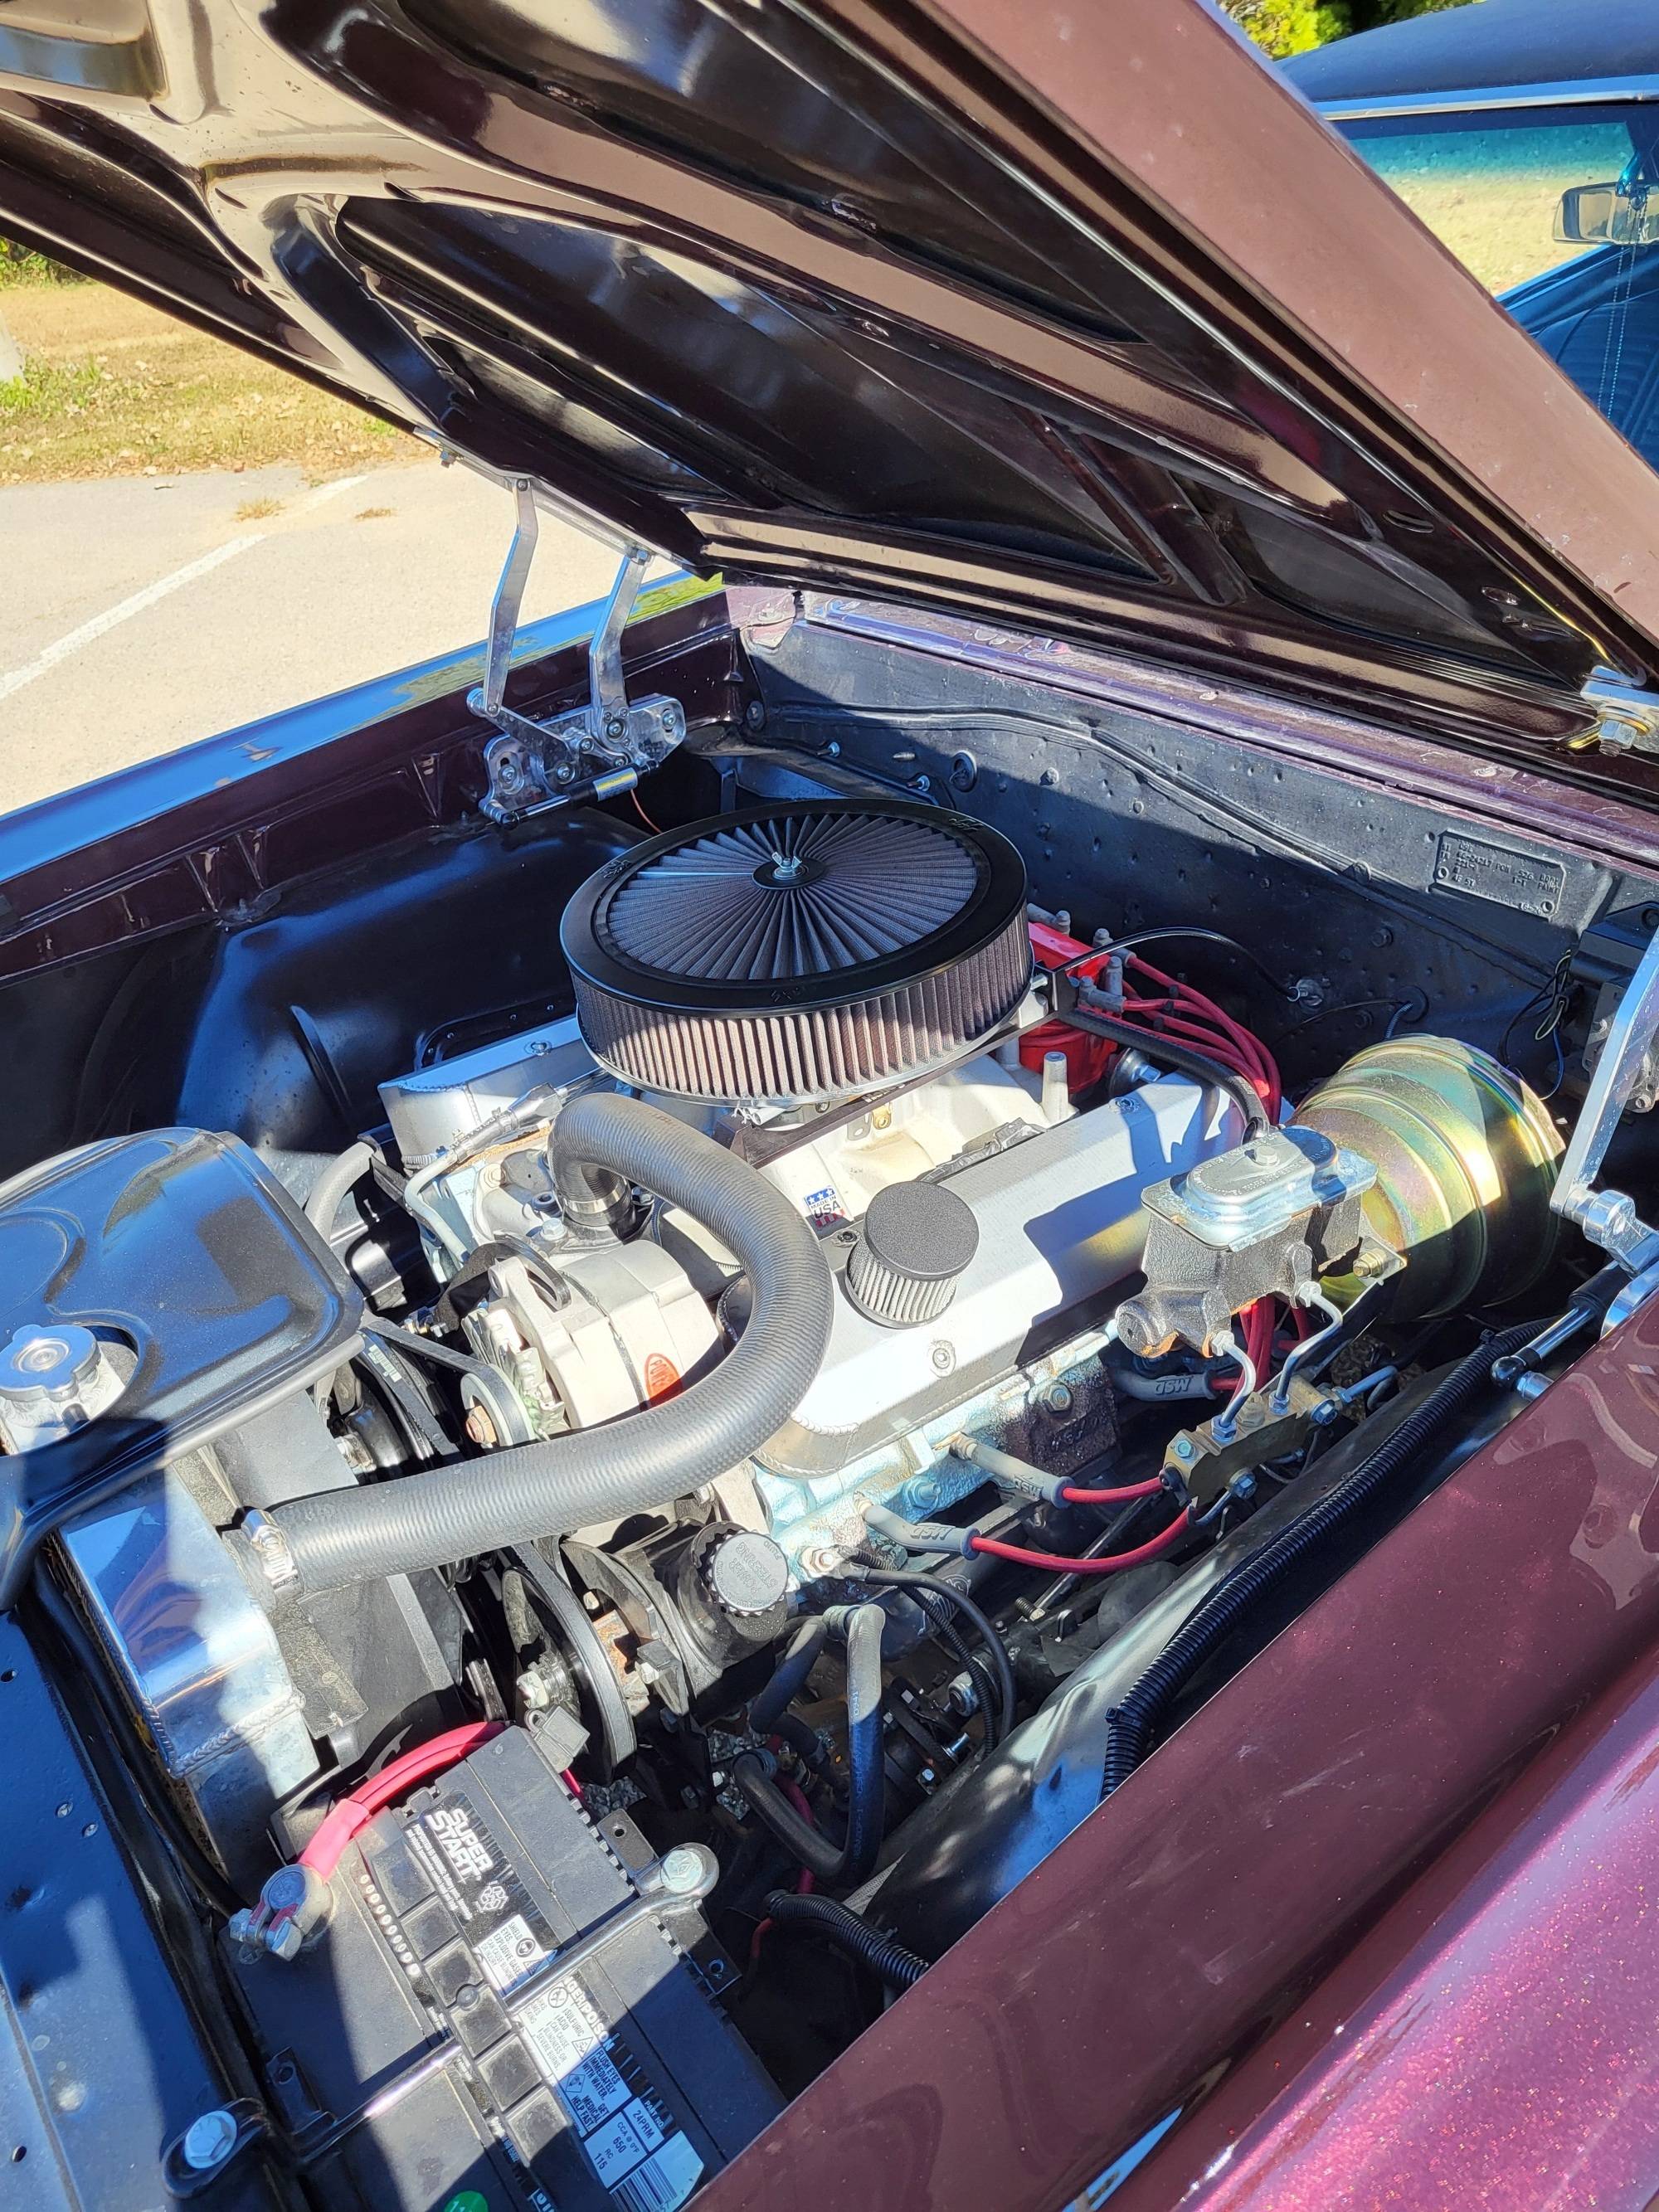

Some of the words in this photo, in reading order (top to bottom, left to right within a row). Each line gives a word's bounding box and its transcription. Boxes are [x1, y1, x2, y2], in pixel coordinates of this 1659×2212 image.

[810, 1198, 828, 1209] MADE
[814, 1200, 841, 1218] USA
[1154, 1377, 1192, 1396] MSD
[1014, 1474, 1043, 1501] MSD
[910, 1524, 953, 1541] MSD
[735, 1541, 777, 1588] STEERING
[424, 1812, 480, 1877] START
[448, 1809, 493, 1874] SUPER
[508, 1921, 522, 1940] SHIELD
[493, 1932, 513, 1961] EXPLOSIVE
[557, 2015, 568, 2030] ACID
[564, 2009, 584, 2036] SULFURIC
[536, 2032, 550, 2051] SEVERE
[550, 2021, 559, 2032] CAN
[556, 2031, 569, 2049] CAUSE
[589, 2055, 615, 2094] IMMEDIATELY
[596, 2049, 611, 2069] FLUSH
[606, 2067, 620, 2084] EYES
[581, 2061, 595, 2078] WITH
[591, 2077, 608, 2100] WATER.
[572, 2095, 584, 2112] HELP
[580, 2111, 594, 2129] FAST.
[581, 2095, 601, 2122] MEDICAL
[597, 2103, 609, 2117] GET
[644, 2100, 656, 2117] PART
[617, 2121, 628, 2136] CCA
[633, 2109, 654, 2138] 24PRM
[605, 2148, 613, 2158] RC
[612, 2136, 626, 2153] 650
[594, 2152, 607, 2169] 115
